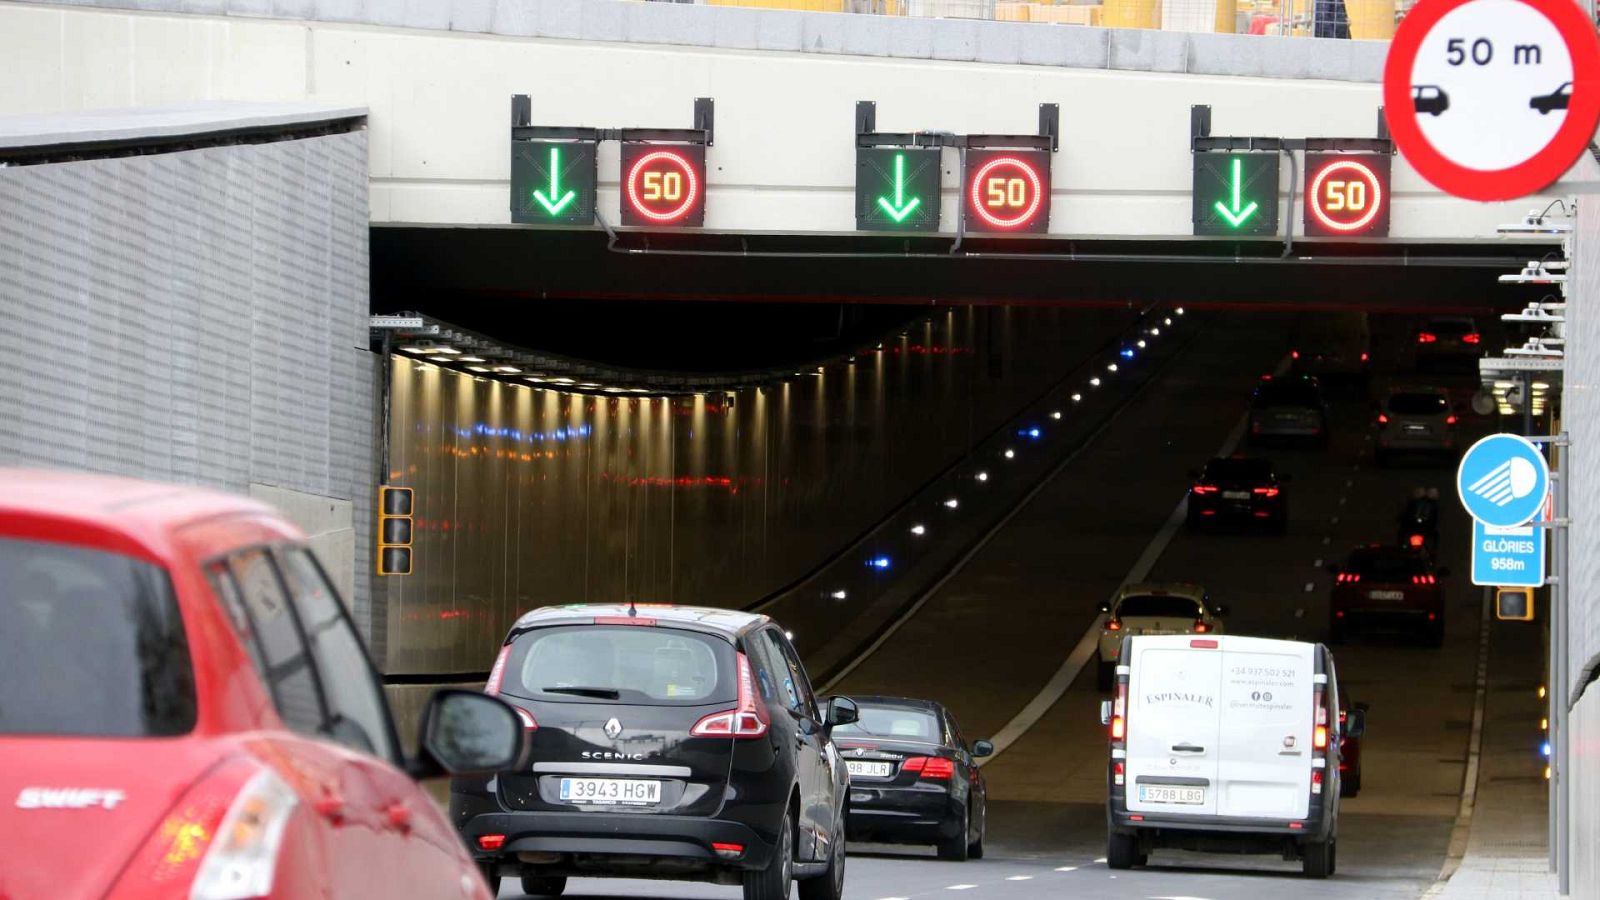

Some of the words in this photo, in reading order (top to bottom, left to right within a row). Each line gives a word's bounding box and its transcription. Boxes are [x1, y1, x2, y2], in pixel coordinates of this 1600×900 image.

[1447, 37, 1493, 66] 50
[1514, 44, 1541, 64] m
[643, 171, 681, 201] 50
[987, 177, 1026, 207] 50
[1326, 180, 1366, 211] 50
[1483, 537, 1534, 553] GLÒRIES
[1491, 557, 1525, 571] 958m
[1146, 692, 1214, 709] ESPINALER
[581, 751, 643, 761] SCENIC
[849, 762, 864, 774] 98
[867, 763, 887, 775] JLR
[15, 787, 126, 809] SWIFT
[575, 781, 618, 797] 3943
[624, 783, 657, 799] HGW
[1148, 789, 1176, 800] 5788
